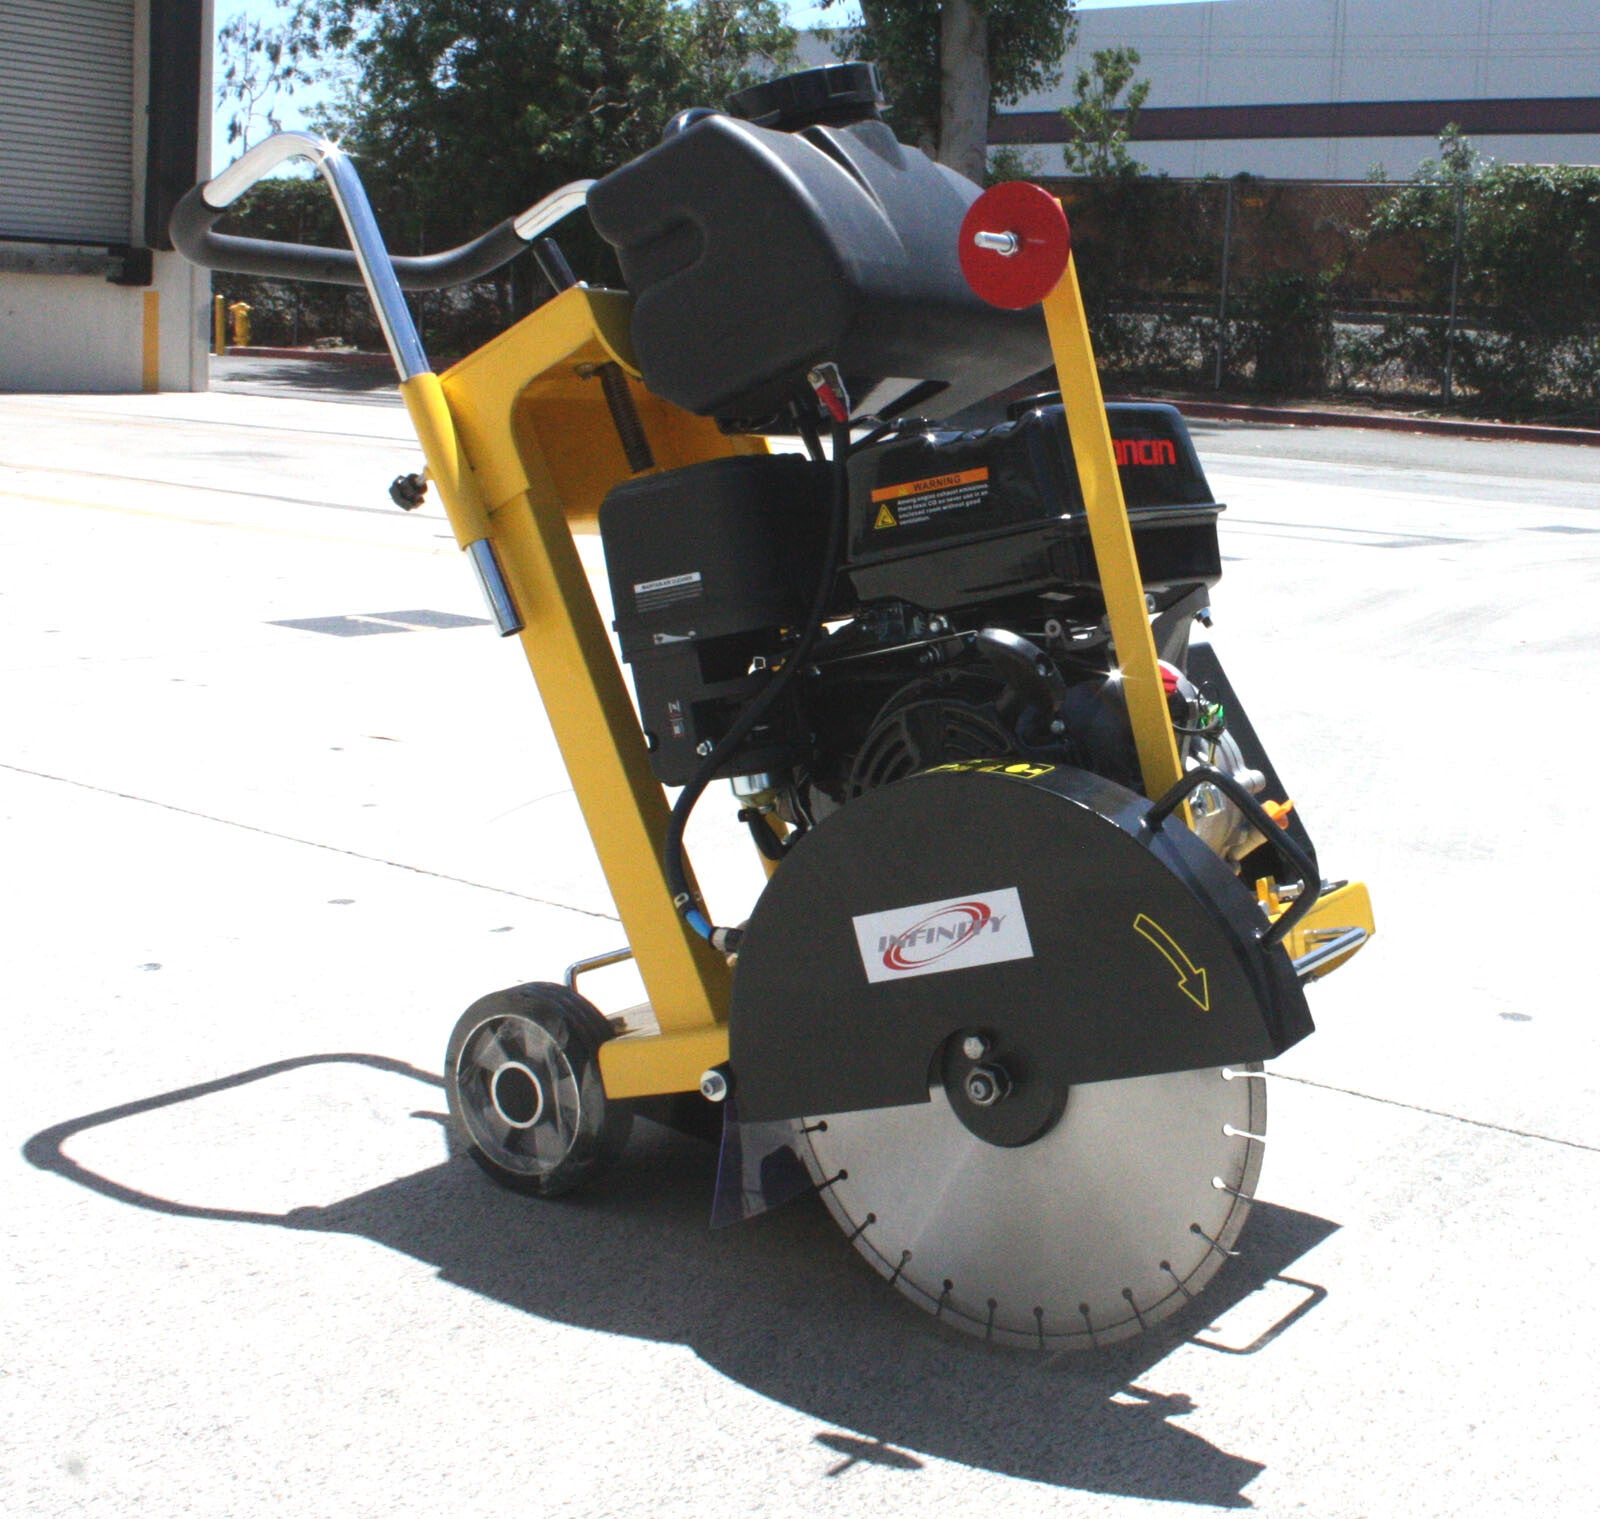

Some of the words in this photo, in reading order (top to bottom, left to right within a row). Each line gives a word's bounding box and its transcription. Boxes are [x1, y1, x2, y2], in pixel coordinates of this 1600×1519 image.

[913, 476, 961, 491] WARNING
[917, 494, 936, 503] engine
[936, 489, 959, 498] exhaust
[927, 499, 938, 507] CO
[898, 509, 925, 519] enclosed
[926, 506, 942, 514] room
[942, 501, 965, 510] without
[965, 498, 981, 507] good
[672, 575, 693, 583] CLEANER
[878, 914, 1007, 952] INFINITY
